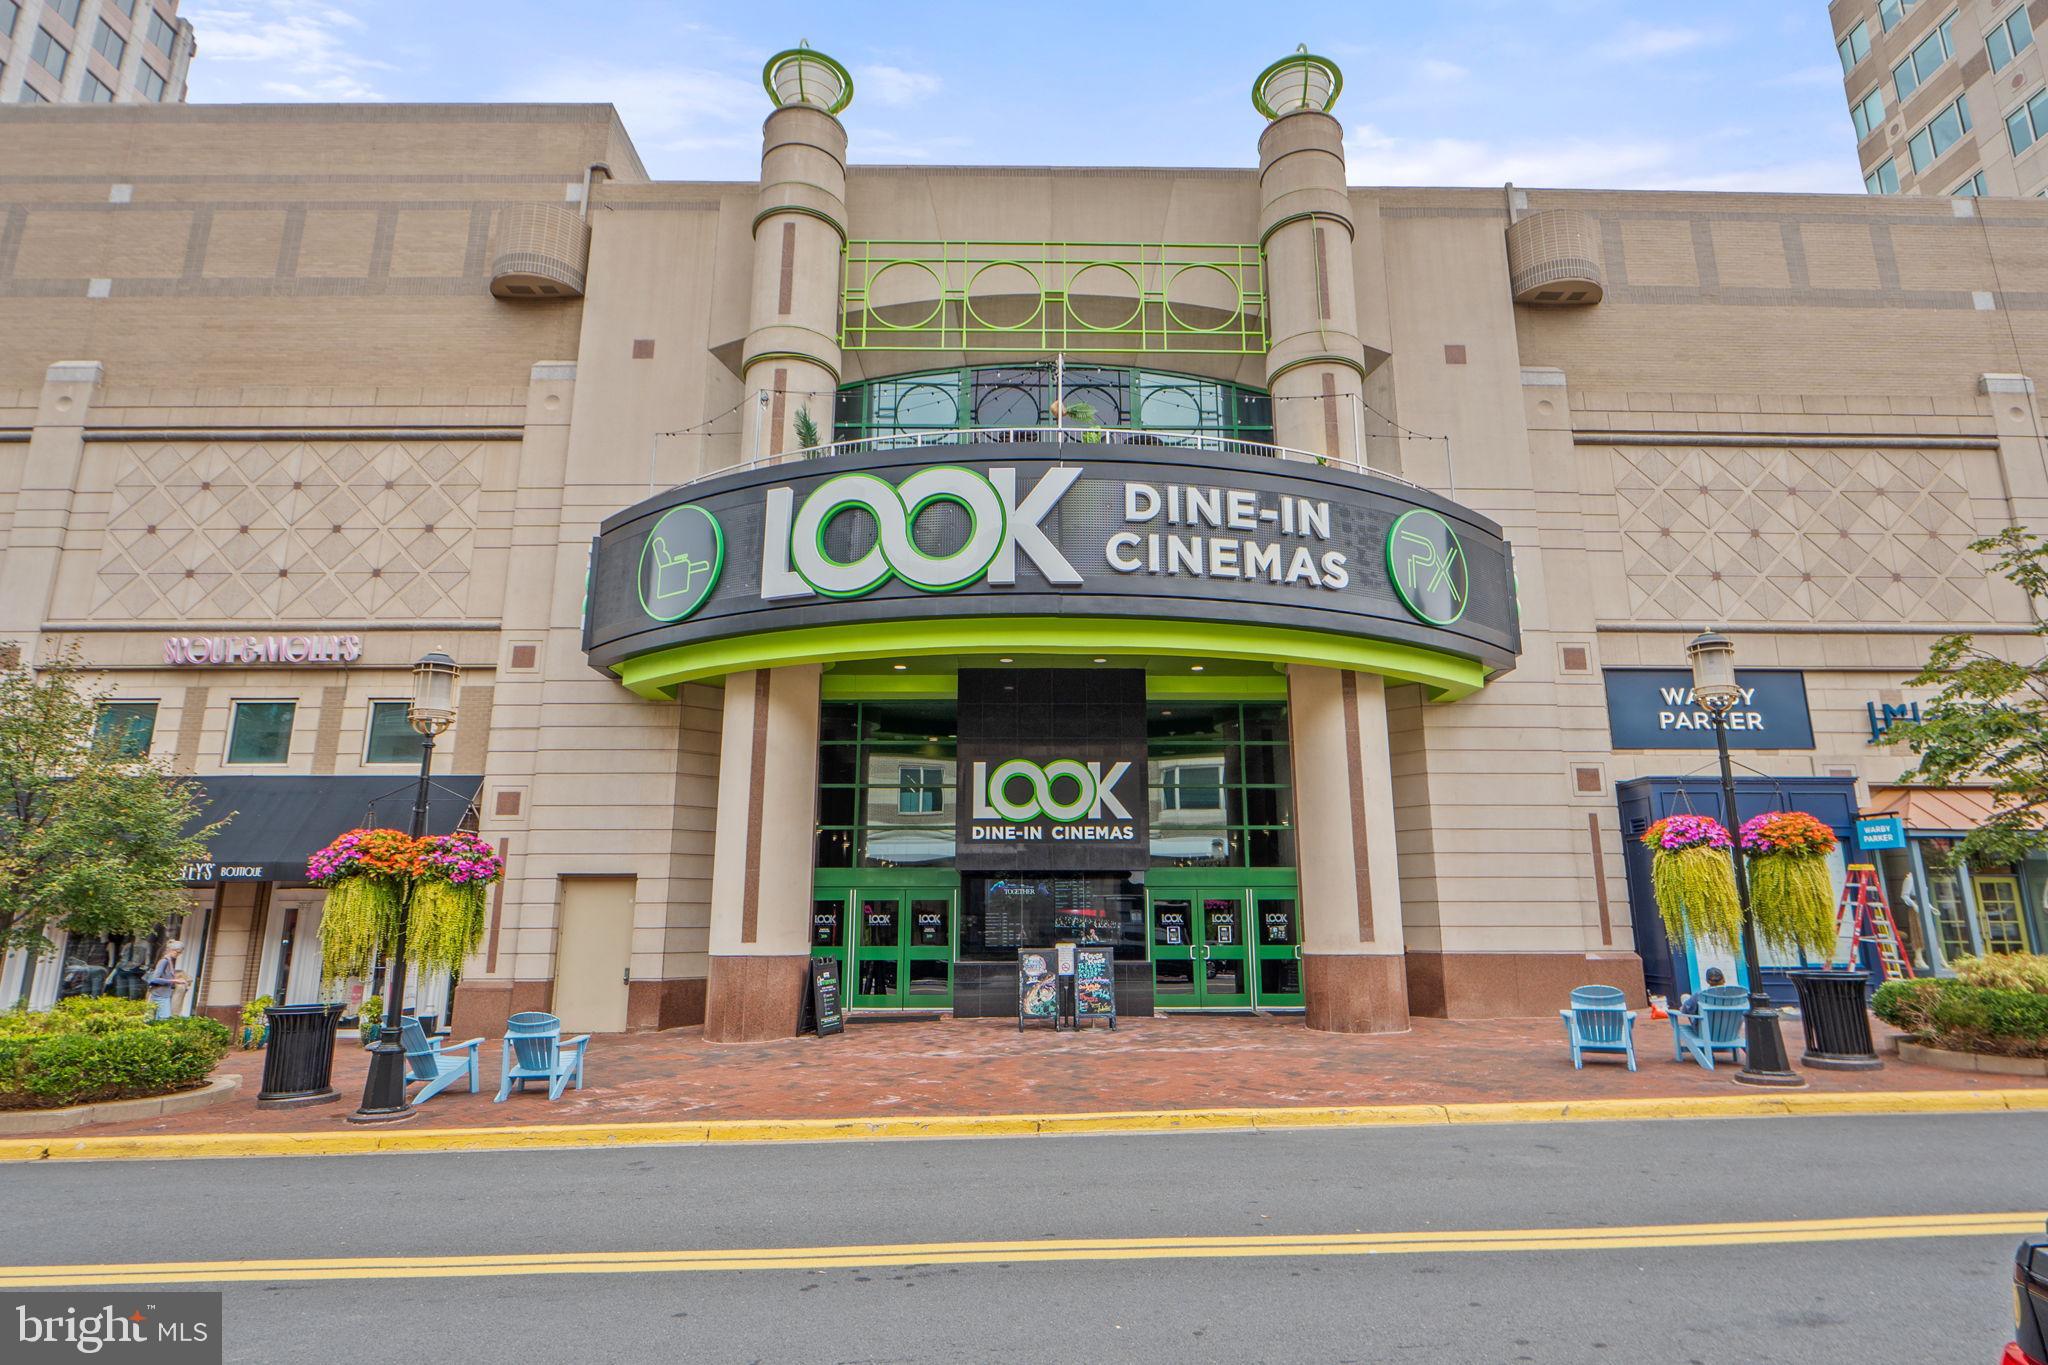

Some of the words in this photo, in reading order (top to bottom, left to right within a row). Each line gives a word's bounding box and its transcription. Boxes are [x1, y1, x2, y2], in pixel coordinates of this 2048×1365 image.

[1125, 482, 1331, 540] DINE-IN
[761, 465, 1084, 600] LOOK
[1106, 532, 1350, 590] CINEMAS
[163, 636, 238, 664] SCOUT
[239, 636, 257, 663] &
[259, 635, 360, 663] MOLLY'S
[973, 758, 1133, 823] LOOK
[972, 826, 1042, 840] DINE-IN
[1052, 826, 1133, 840] CINEMAS
[1864, 825, 1891, 834] WARBY
[1863, 834, 1894, 843] PARKER
[220, 866, 263, 877] BOUTIQUE
[814, 914, 837, 923] LOOK
[868, 914, 891, 924] LOOK
[918, 914, 941, 924] LOOK
[1161, 913, 1184, 923] LOOK
[1212, 913, 1234, 923] LOOK
[1265, 913, 1288, 923] LOOK
